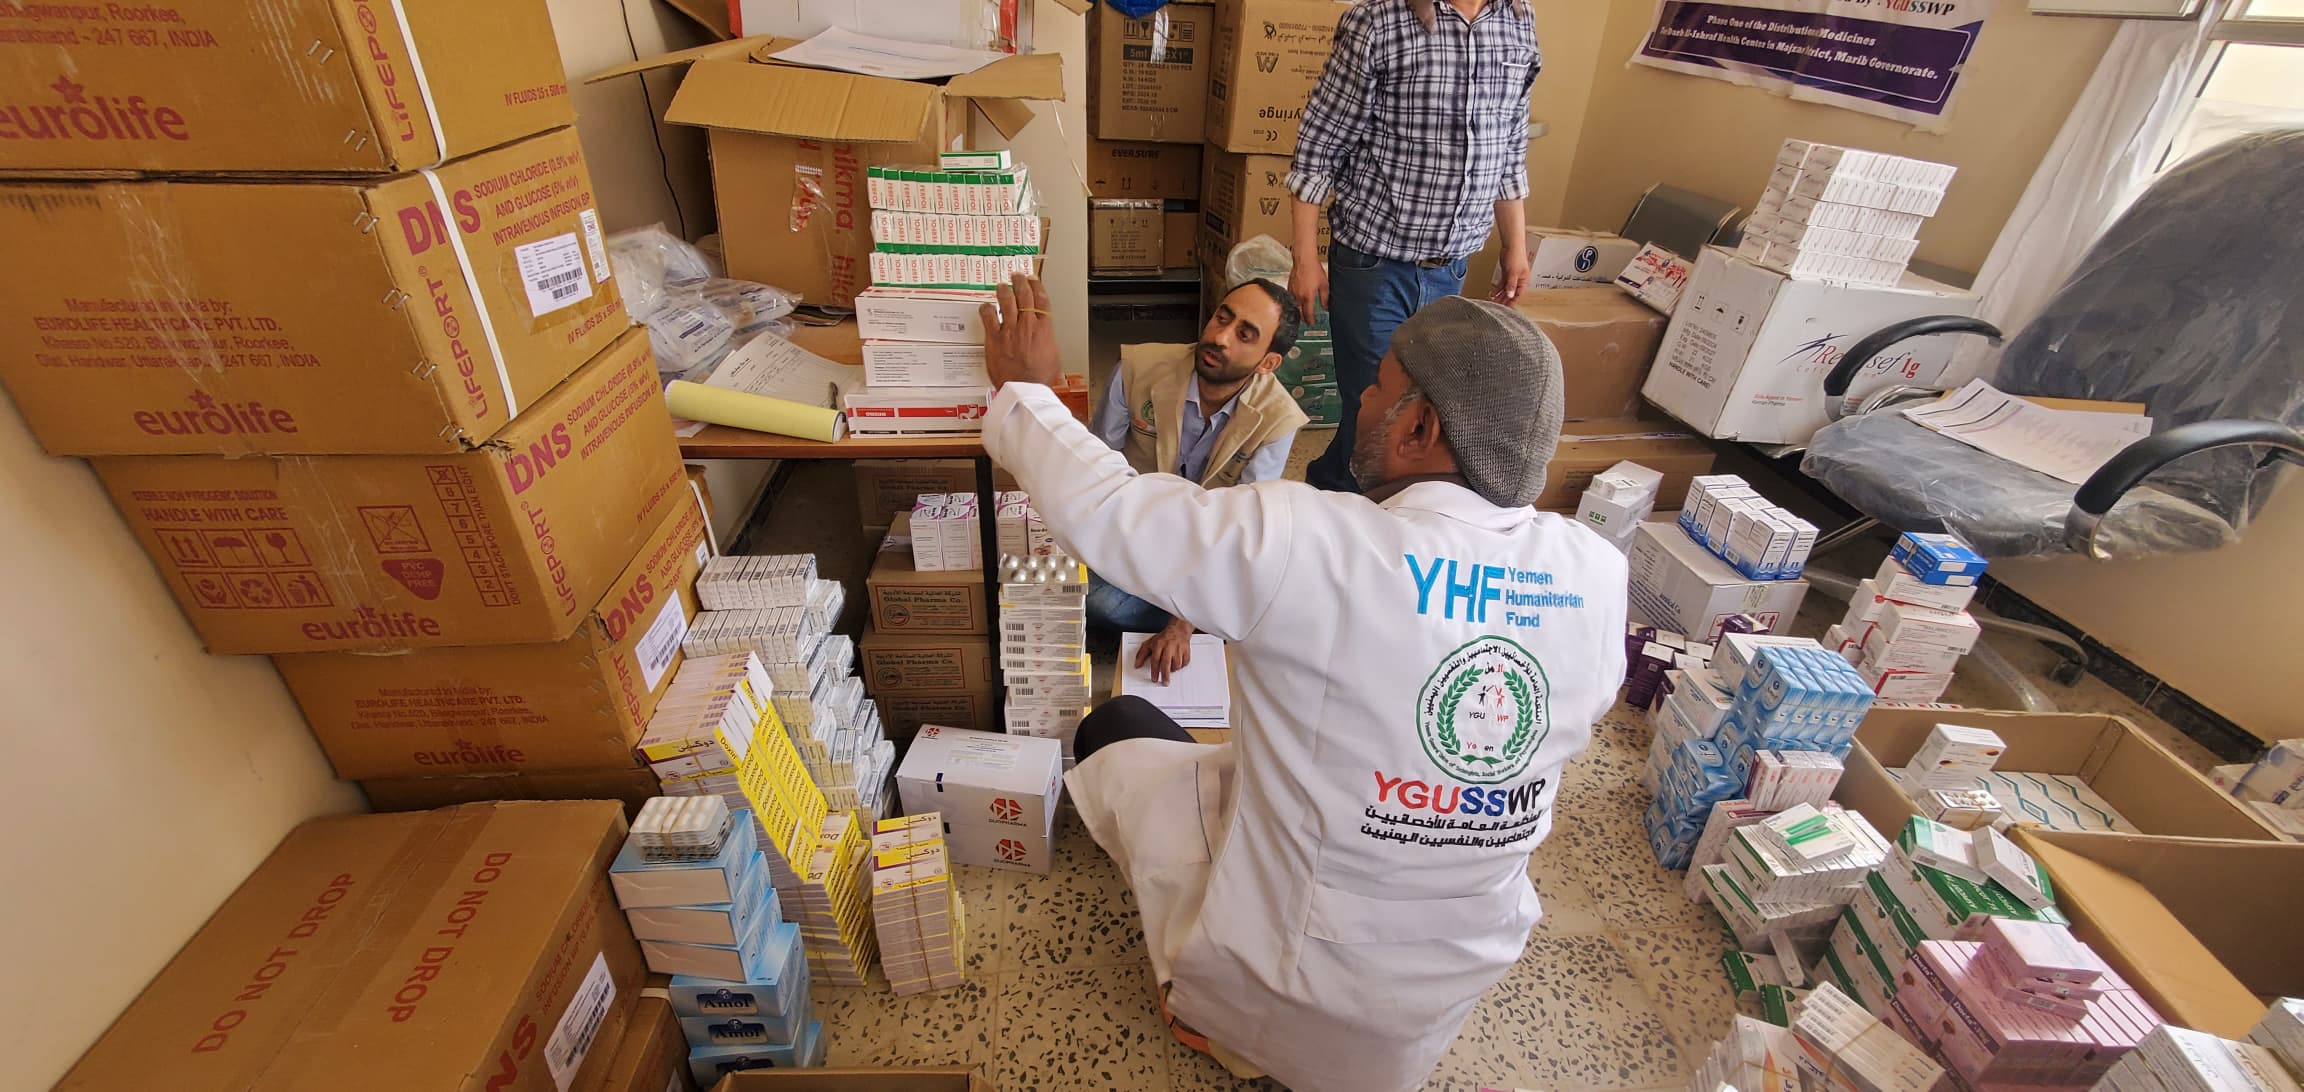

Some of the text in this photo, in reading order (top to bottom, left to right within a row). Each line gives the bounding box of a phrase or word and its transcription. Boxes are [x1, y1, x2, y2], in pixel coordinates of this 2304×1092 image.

[93, 28, 122, 45] 247
[128, 29, 158, 46] 667
[1707, 15, 1728, 26] Phase
[1729, 17, 1744, 28] One
[1744, 18, 1753, 29] of
[1752, 20, 1767, 31] the
[1718, 34, 1741, 45] Health
[1741, 37, 1766, 48] Center
[1766, 40, 1775, 49] in
[1834, 51, 1868, 66] Marib
[1868, 58, 1939, 80] Governorate.
[0, 96, 189, 141] eurolife
[1259, 107, 1301, 121] yringe
[474, 177, 510, 198] SODIUM
[510, 161, 550, 186] CHLORIDE
[495, 202, 516, 219] AND
[514, 186, 553, 212] GLUCOSE
[398, 189, 482, 256] DNS
[493, 211, 551, 248] INTRAVENOUS
[549, 196, 583, 222] INFUSION
[33, 317, 112, 331] EUROLIFE
[249, 317, 282, 332] LTD.
[1900, 358, 1921, 379] 1g
[567, 397, 596, 426] SODIUM
[594, 369, 627, 404] CHLORIDE
[583, 419, 599, 437] AND
[597, 389, 629, 424] GLUCOSE
[132, 400, 298, 436] eurolife
[580, 413, 627, 461] INTRAVENOUS
[504, 422, 573, 496] DNS
[142, 507, 289, 522] HANDLE WITH CARE
[1404, 553, 1505, 623] YHF
[1508, 566, 1553, 585] Yemen
[606, 573, 655, 641] DNS
[1506, 589, 1585, 609] Humanitarian
[301, 611, 441, 641] eurolife
[1506, 612, 1540, 628] Fund
[1468, 711, 1486, 720] YGU
[413, 746, 526, 765] eurolife
[720, 737, 737, 760] Doxin
[1374, 770, 1546, 817] YGUSSWP
[387, 851, 513, 1024] DO NOT DROP
[191, 872, 357, 1054] DO NOT DROP
